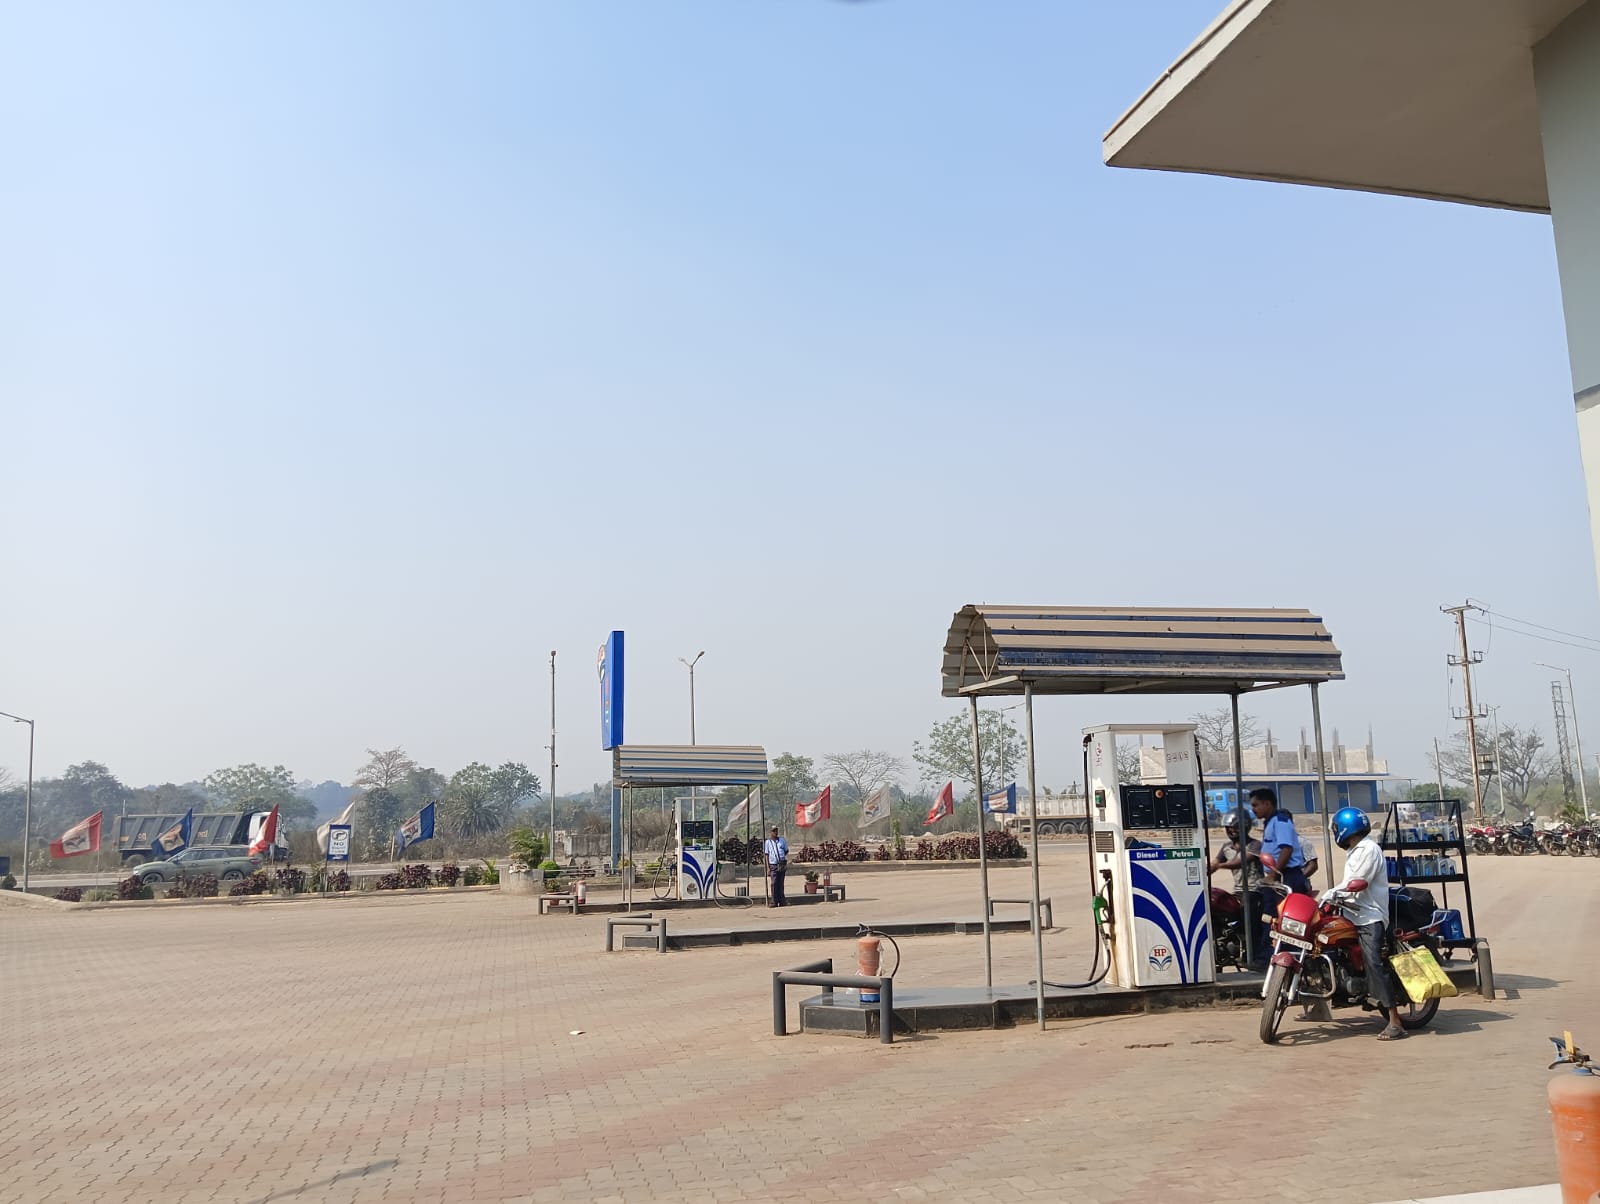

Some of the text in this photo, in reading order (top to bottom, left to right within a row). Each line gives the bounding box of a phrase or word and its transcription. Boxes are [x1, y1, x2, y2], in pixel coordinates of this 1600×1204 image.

[1136, 850, 1194, 859] Diesel Petrol
[1154, 948, 1166, 956] HP
